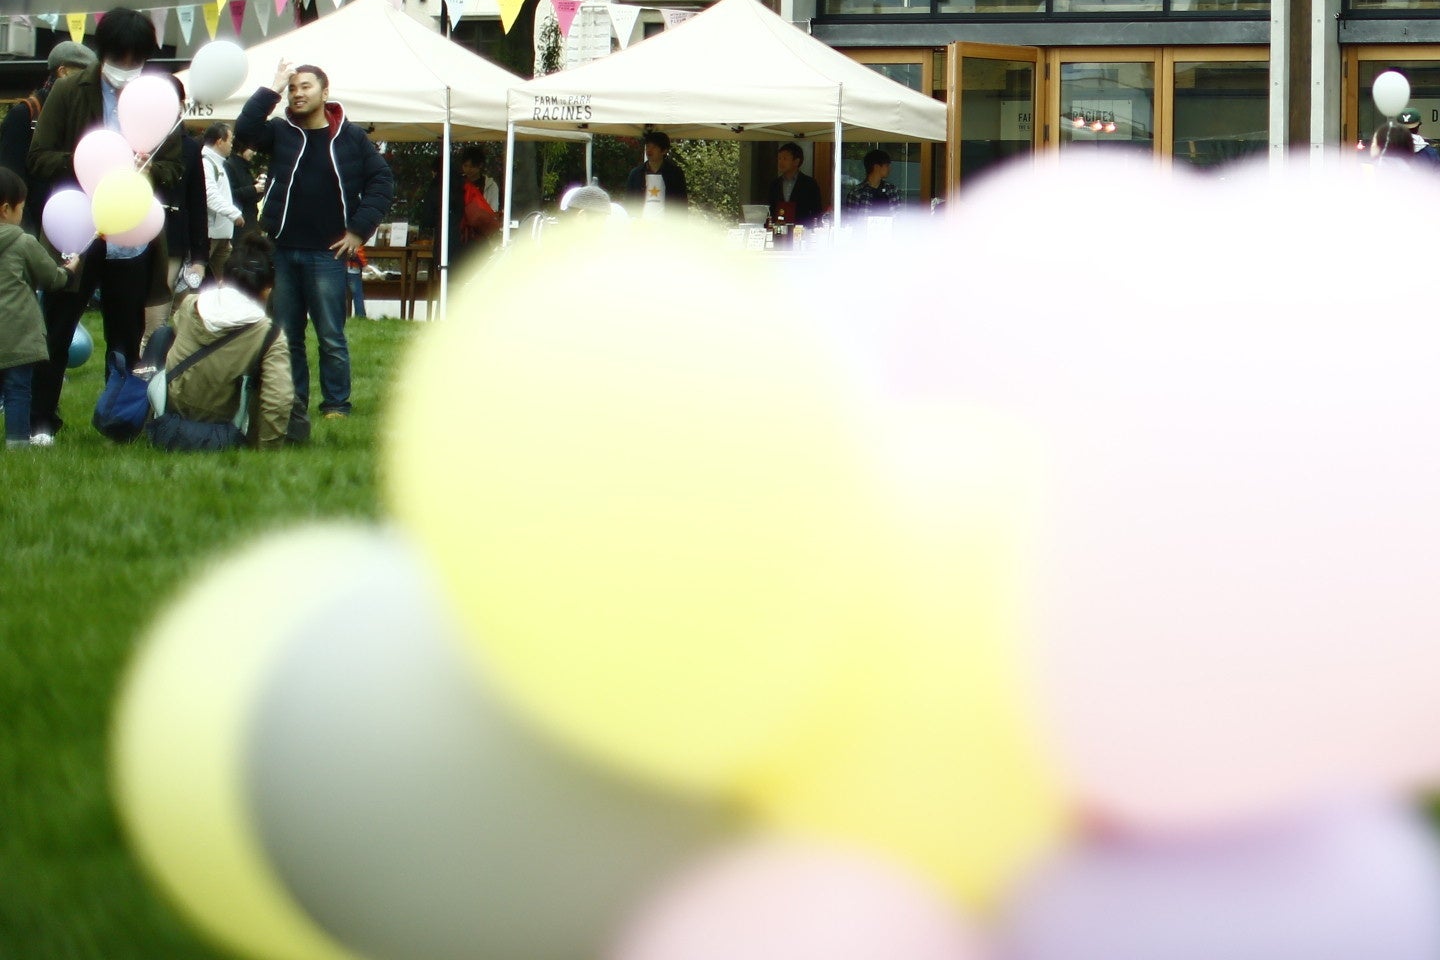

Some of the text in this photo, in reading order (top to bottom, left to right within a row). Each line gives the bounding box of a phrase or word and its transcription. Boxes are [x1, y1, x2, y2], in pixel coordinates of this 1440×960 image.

[535, 96, 558, 105] FARM
[568, 95, 591, 105] PARK
[533, 105, 592, 120] RACINES
